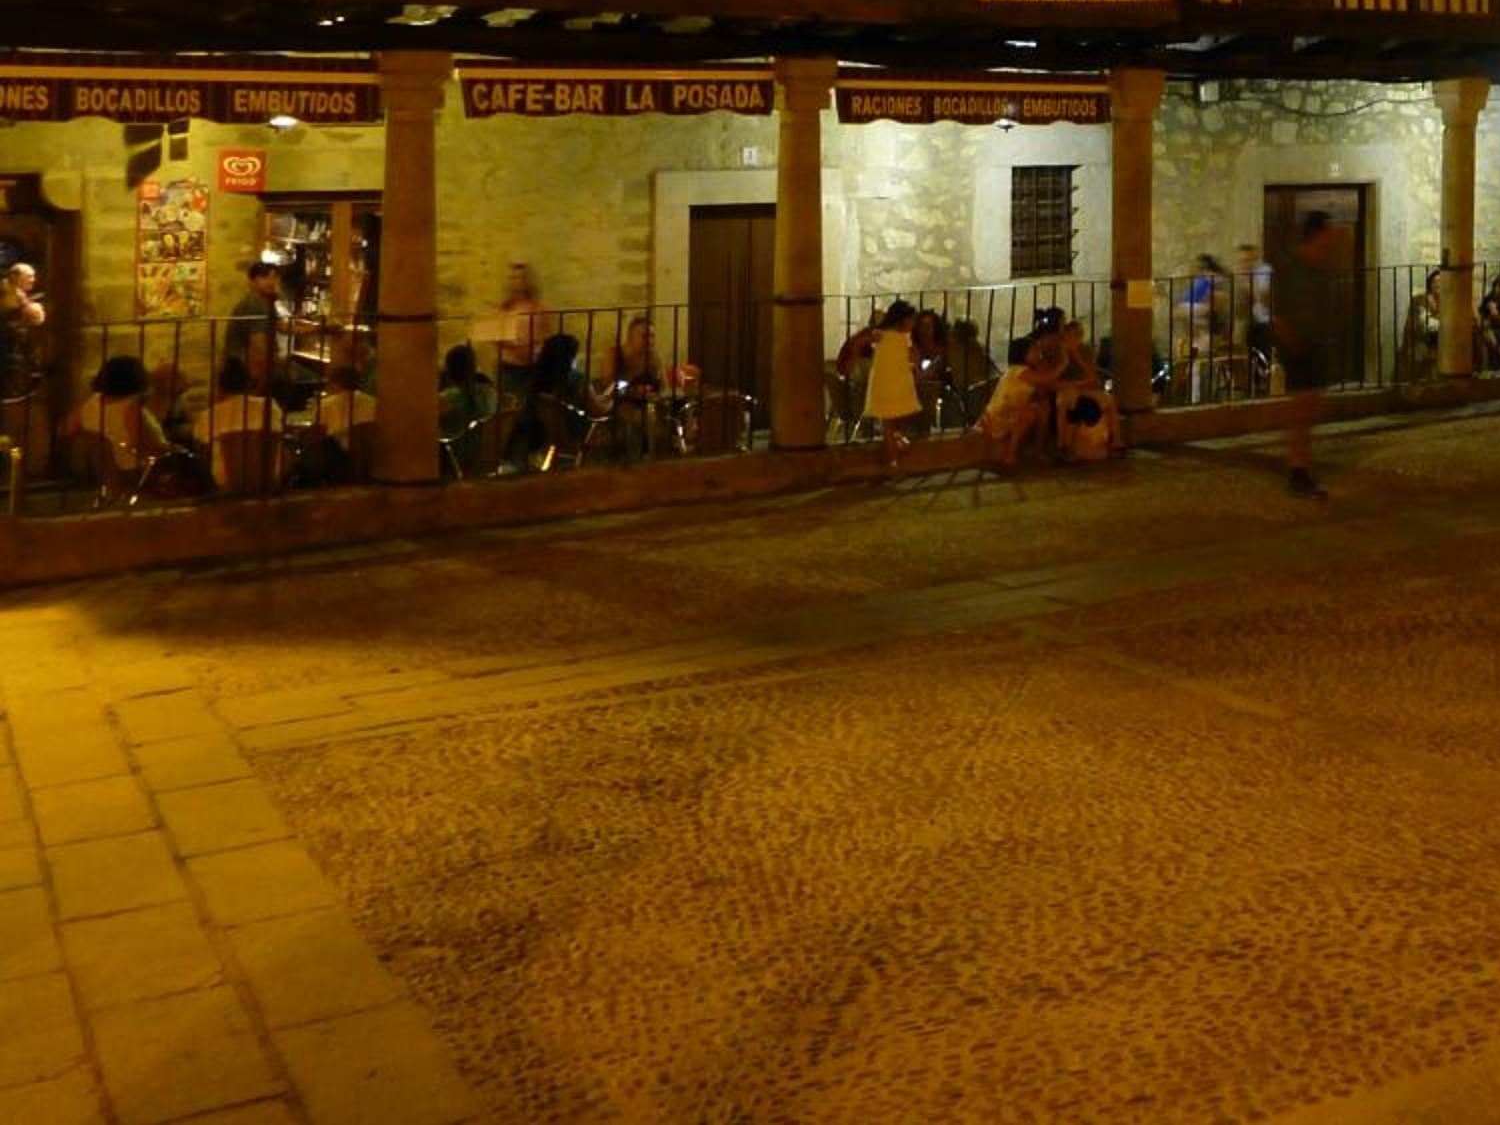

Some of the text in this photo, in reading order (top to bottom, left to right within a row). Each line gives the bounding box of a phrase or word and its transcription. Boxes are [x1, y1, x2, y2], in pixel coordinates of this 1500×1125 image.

[76, 87, 200, 114] BOCADILLOS
[234, 89, 357, 114] EMBUTIDOS
[625, 85, 656, 110] LA
[672, 84, 766, 109] POSADA
[851, 95, 922, 116] RACIONES
[1023, 98, 1097, 117] EMBUTIDOS
